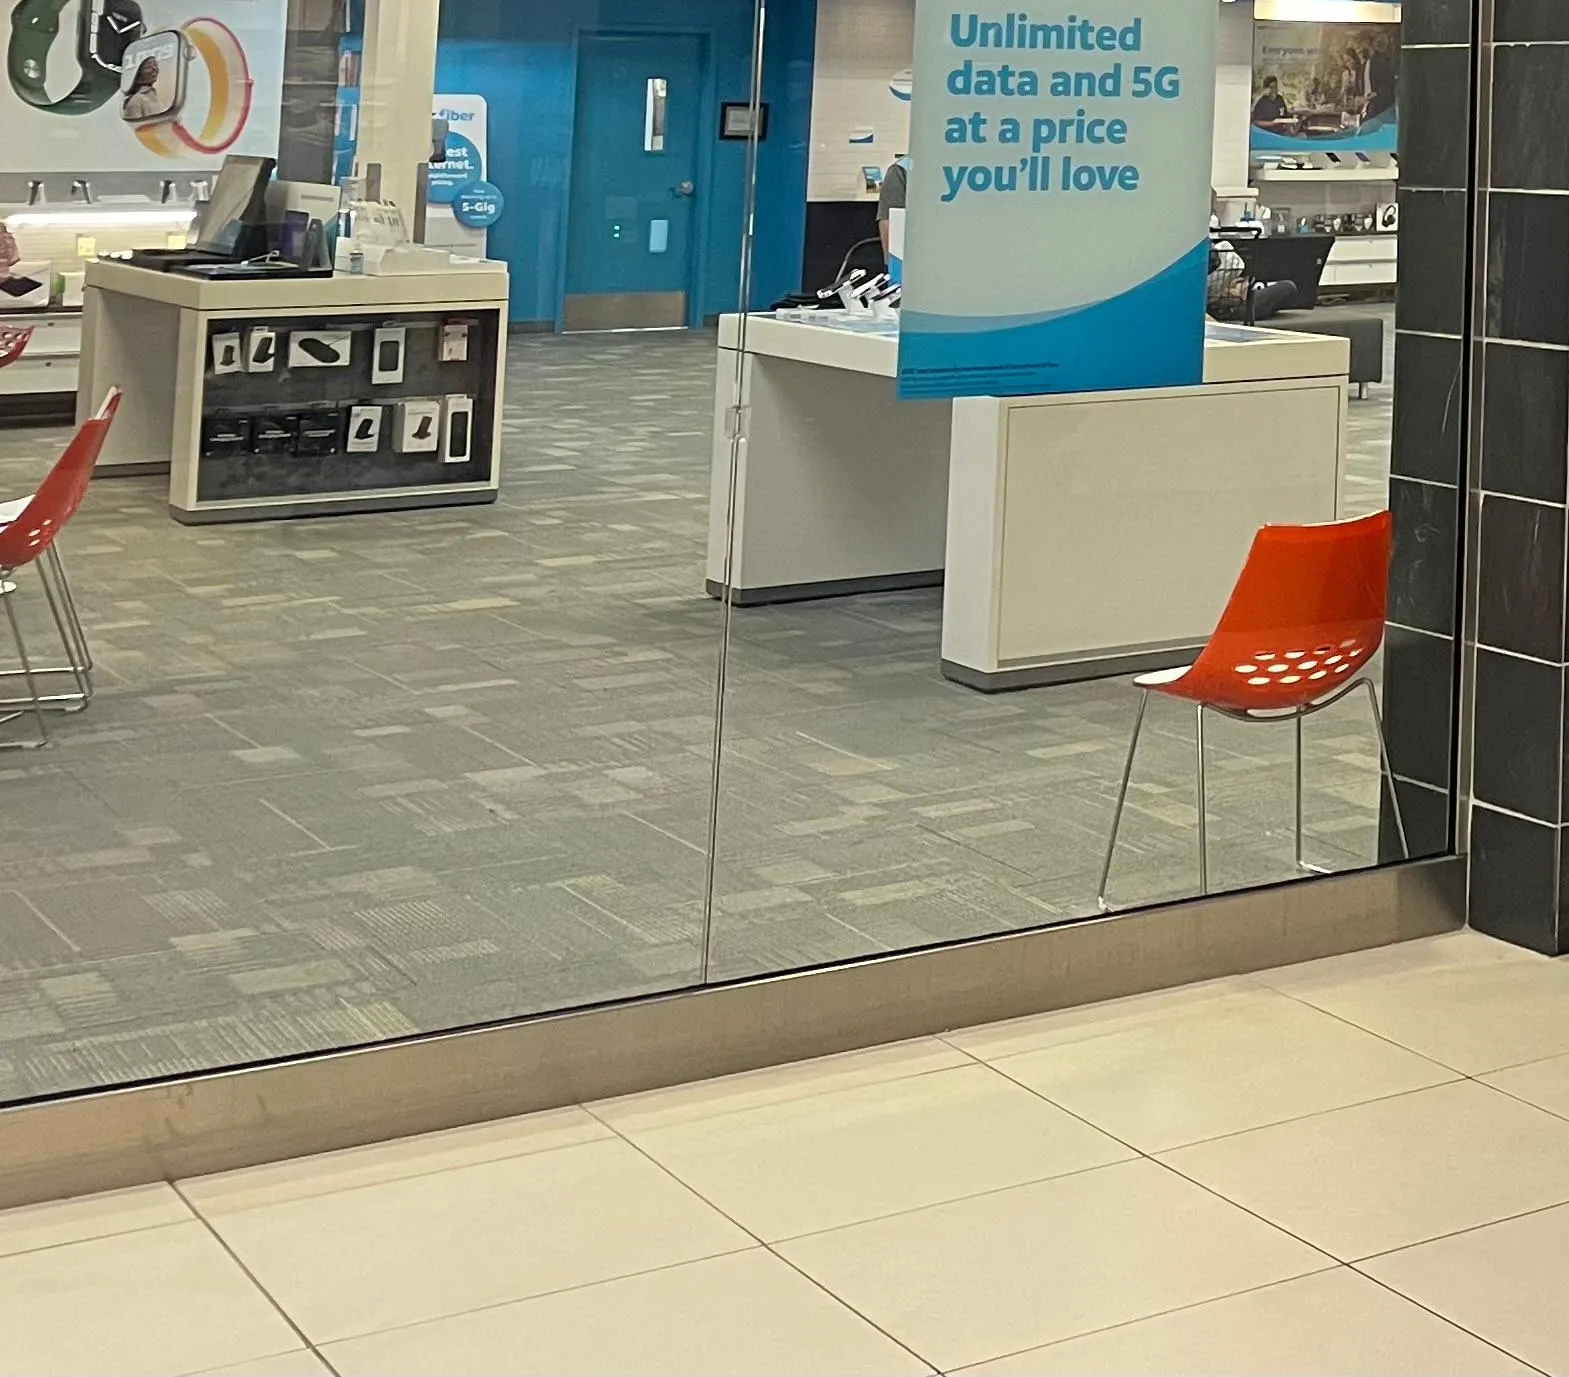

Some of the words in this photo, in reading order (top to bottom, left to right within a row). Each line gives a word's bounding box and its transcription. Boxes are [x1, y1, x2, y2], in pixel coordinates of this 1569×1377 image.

[950, 13, 1142, 52] Unlimited
[947, 60, 1038, 97] data
[1050, 63, 1122, 98] and
[1131, 66, 1180, 99] 5G
[944, 112, 987, 144] at
[998, 118, 1020, 144] a
[1032, 109, 1128, 153] price
[940, 156, 1050, 202] you'll
[1061, 156, 1139, 192] love
